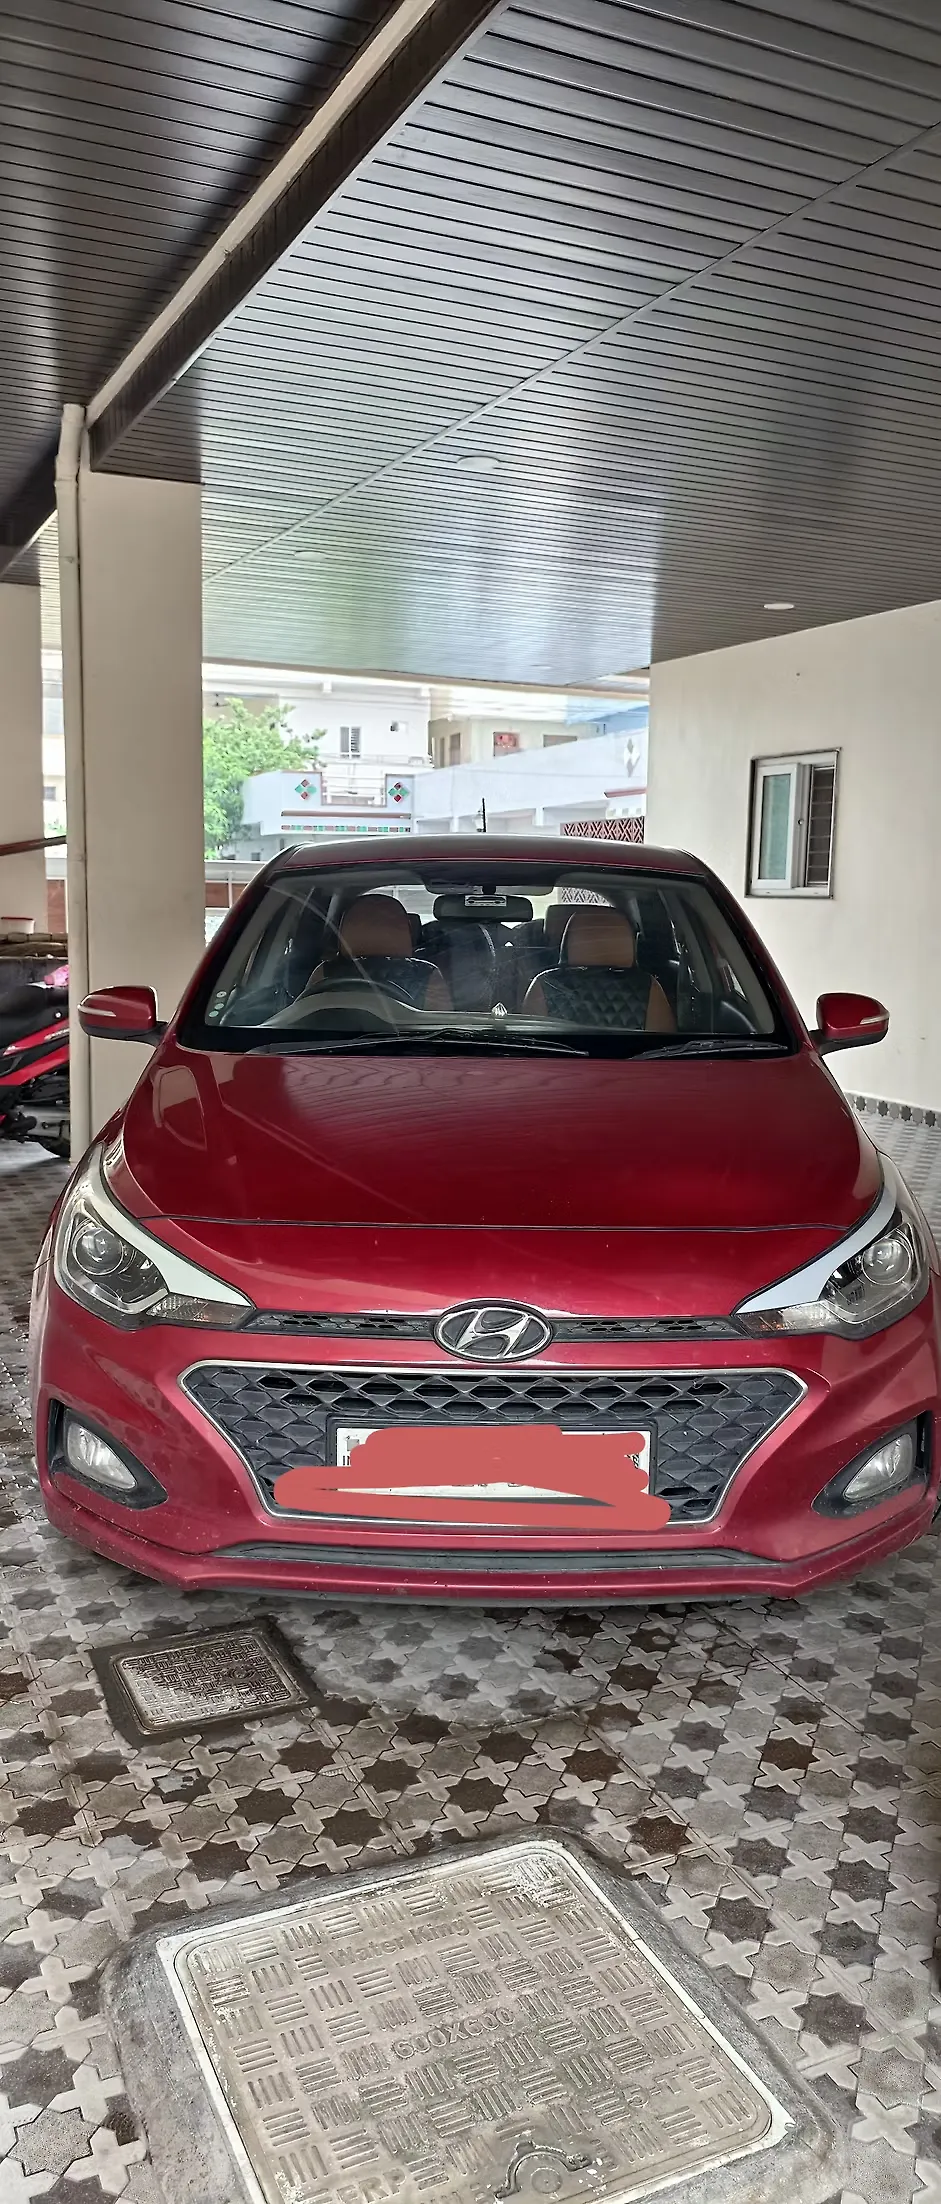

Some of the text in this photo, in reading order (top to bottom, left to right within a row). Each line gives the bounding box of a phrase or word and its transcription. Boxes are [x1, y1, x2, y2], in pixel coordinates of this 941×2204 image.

[328, 1911, 470, 1967] Water King
[392, 2007, 515, 2059] 600X600
[620, 2069, 682, 2108] 5-T
